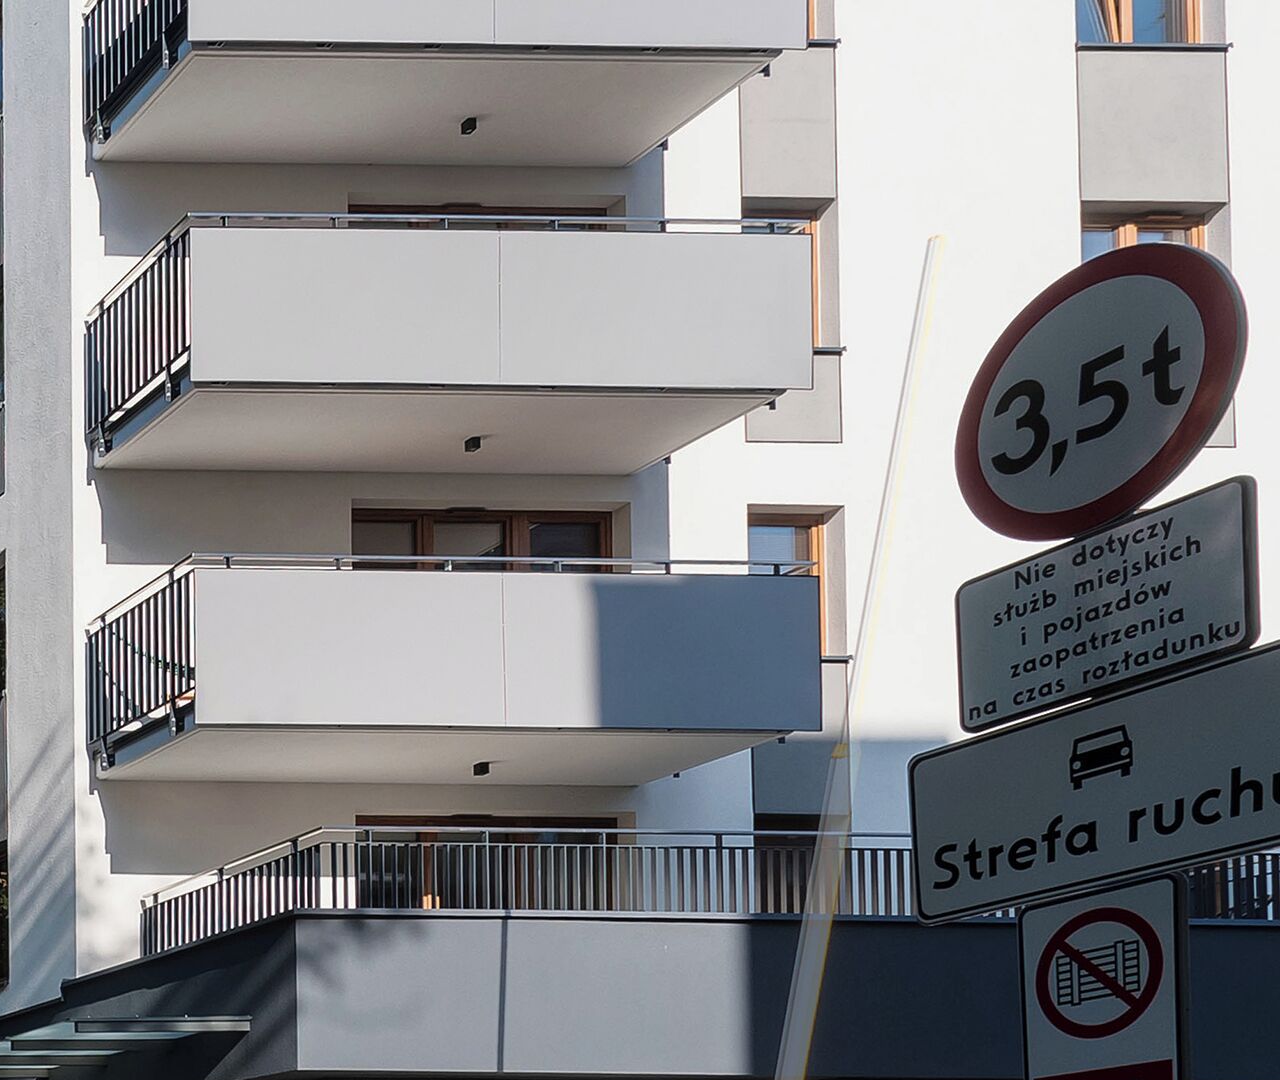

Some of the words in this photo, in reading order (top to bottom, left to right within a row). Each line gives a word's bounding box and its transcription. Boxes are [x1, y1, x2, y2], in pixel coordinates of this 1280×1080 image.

[993, 588, 1057, 628] służb
[1074, 535, 1202, 597] miejskich
[1014, 564, 1056, 590] Nie
[1072, 516, 1175, 568] dotyczy
[1010, 605, 1184, 679] zaopatrzenia
[1020, 625, 1027, 646] i
[1043, 578, 1172, 645] pojazdów
[968, 700, 998, 722] na
[1012, 678, 1066, 707] czas
[1082, 619, 1240, 685] rozładunku
[932, 814, 1098, 890] Strefa
[1128, 766, 1280, 843] ruch
